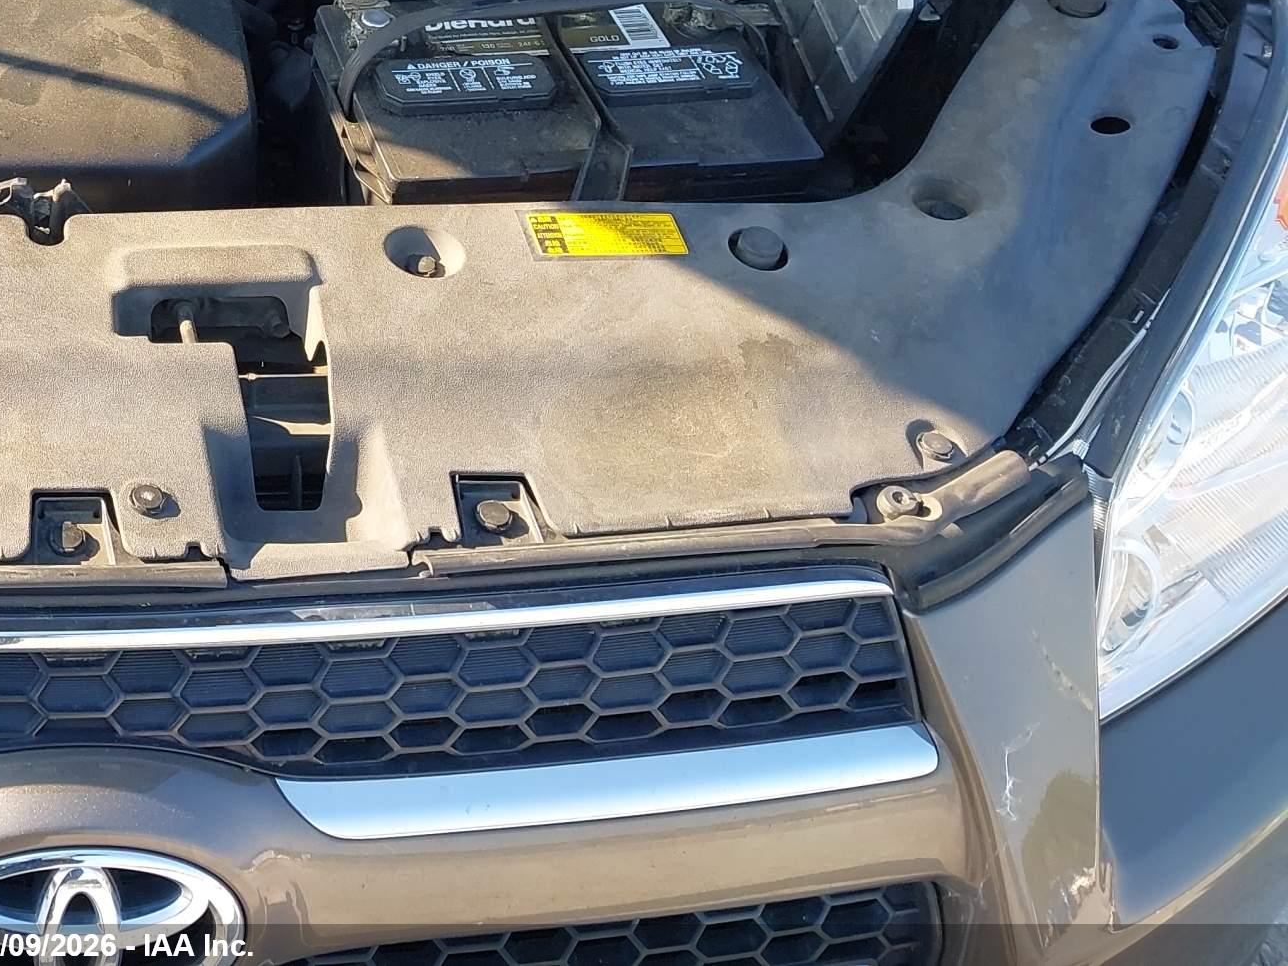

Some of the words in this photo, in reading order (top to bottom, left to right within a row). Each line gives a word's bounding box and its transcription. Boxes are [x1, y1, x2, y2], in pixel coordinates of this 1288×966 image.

[589, 34, 620, 43] GOLD
[417, 61, 461, 70] DANGER
[471, 58, 511, 67] POISON
